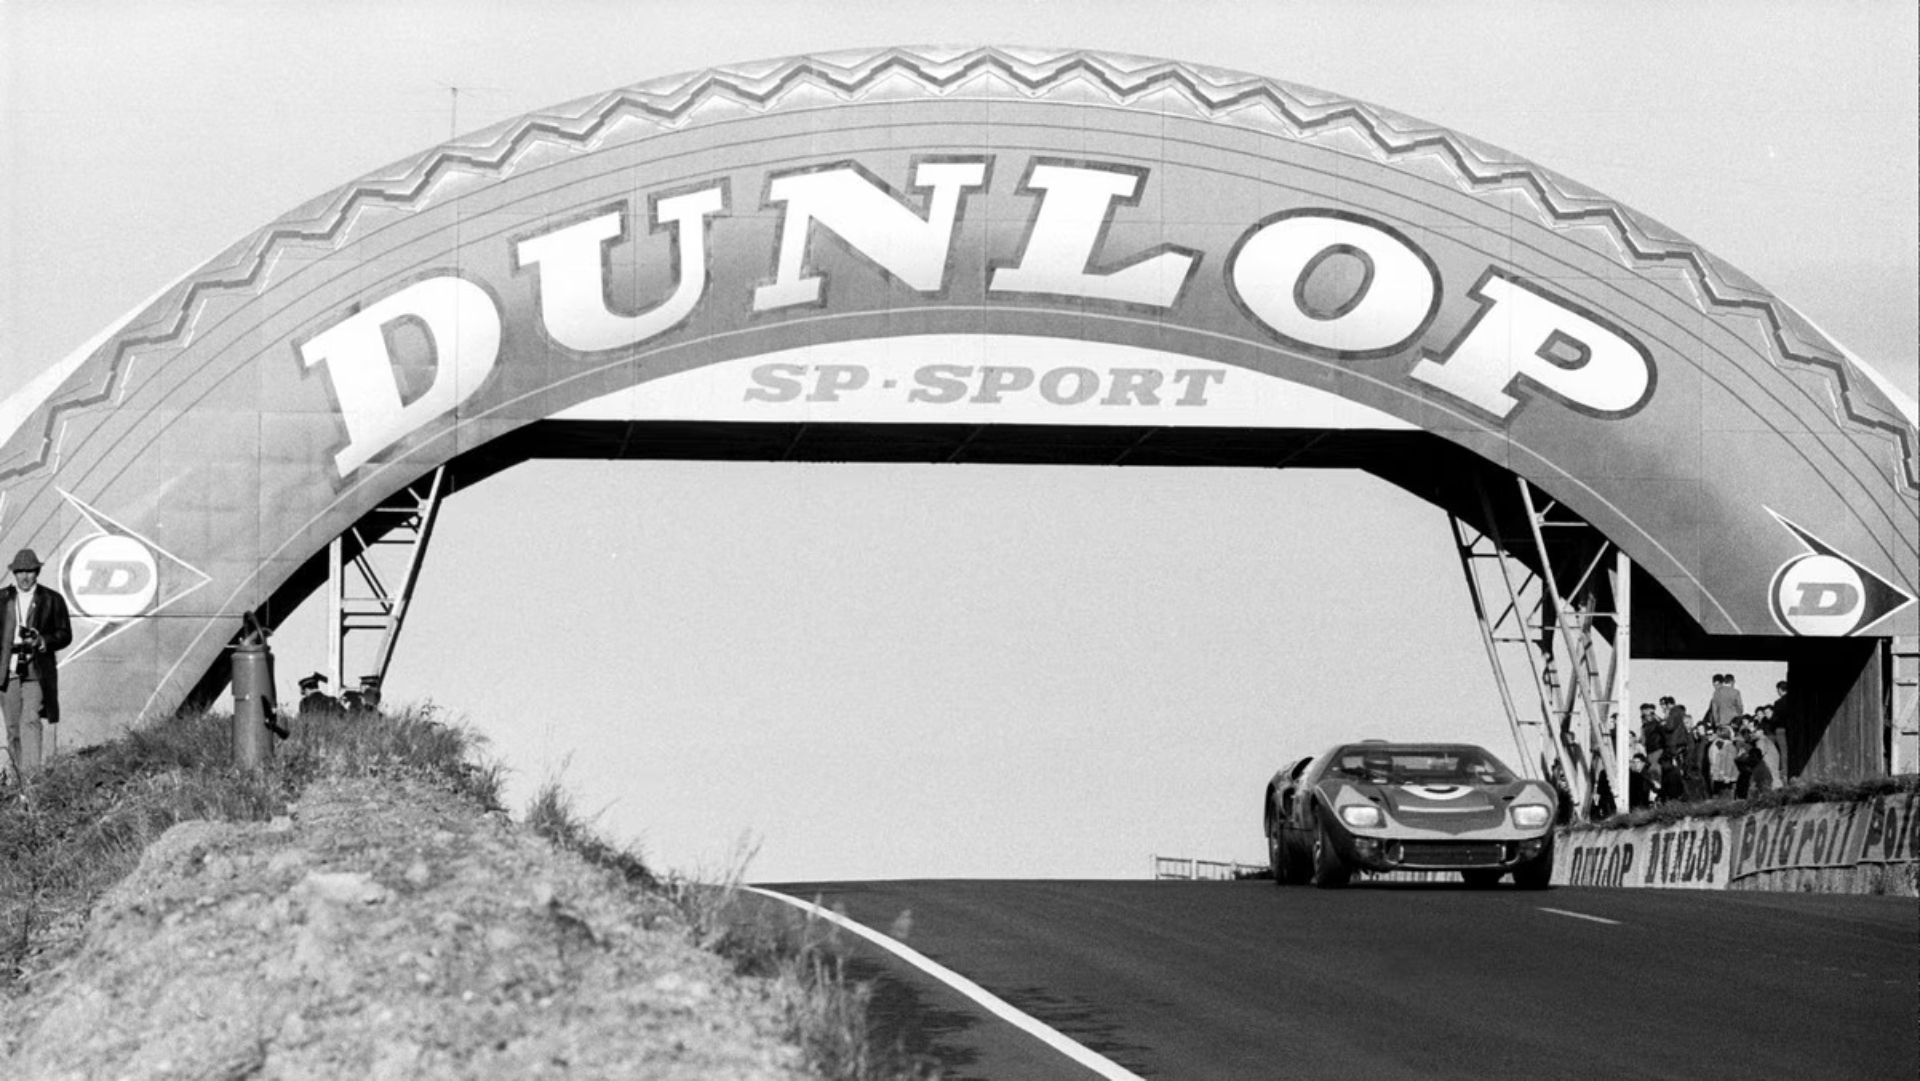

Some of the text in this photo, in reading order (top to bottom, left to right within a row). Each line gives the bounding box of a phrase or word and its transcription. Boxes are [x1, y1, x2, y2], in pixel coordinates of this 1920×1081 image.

[298, 158, 1653, 484] DUNLOP
[77, 560, 151, 595] D
[1787, 582, 1859, 616] D
[1570, 843, 1634, 887] DUNLOP
[1645, 828, 1723, 884] DUNLOP
